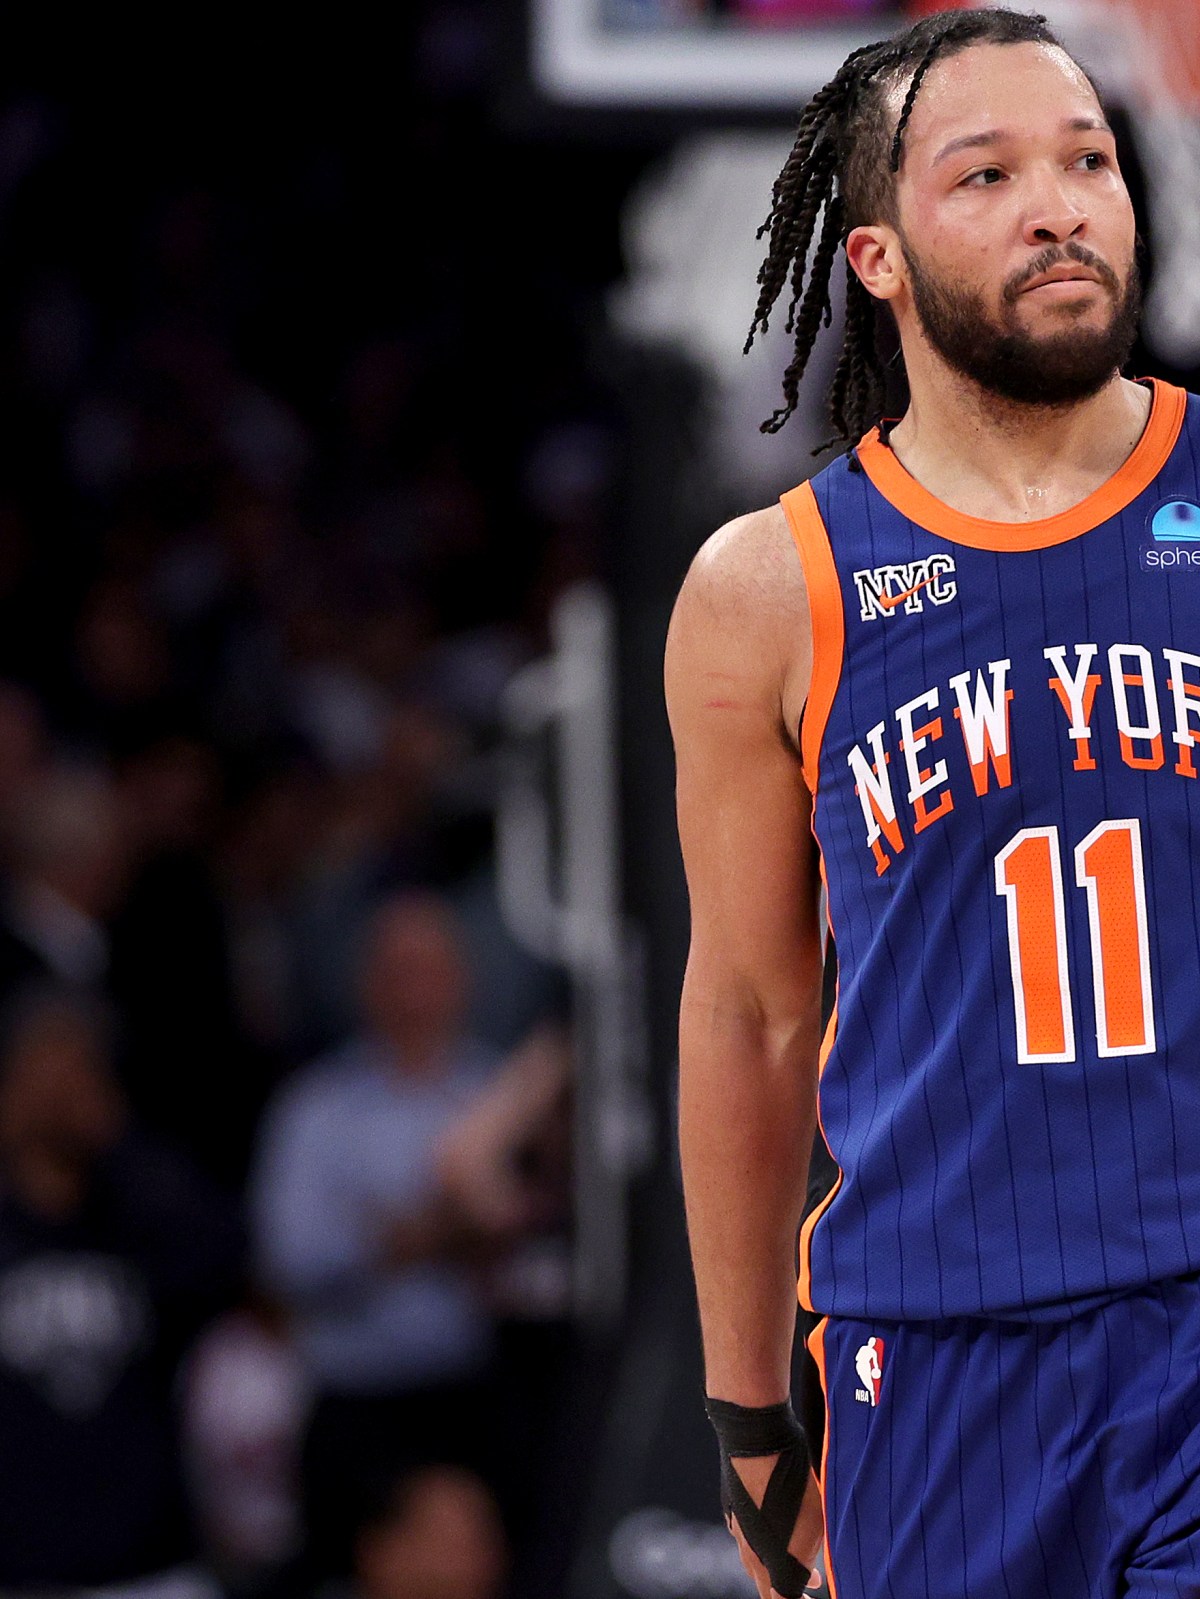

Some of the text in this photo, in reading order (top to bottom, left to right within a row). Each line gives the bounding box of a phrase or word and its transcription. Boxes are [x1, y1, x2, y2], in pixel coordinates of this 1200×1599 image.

[853, 553, 957, 622] NYC
[847, 659, 1012, 848] NEW
[994, 818, 1156, 1065] 11
[855, 1388, 870, 1403] NBA
